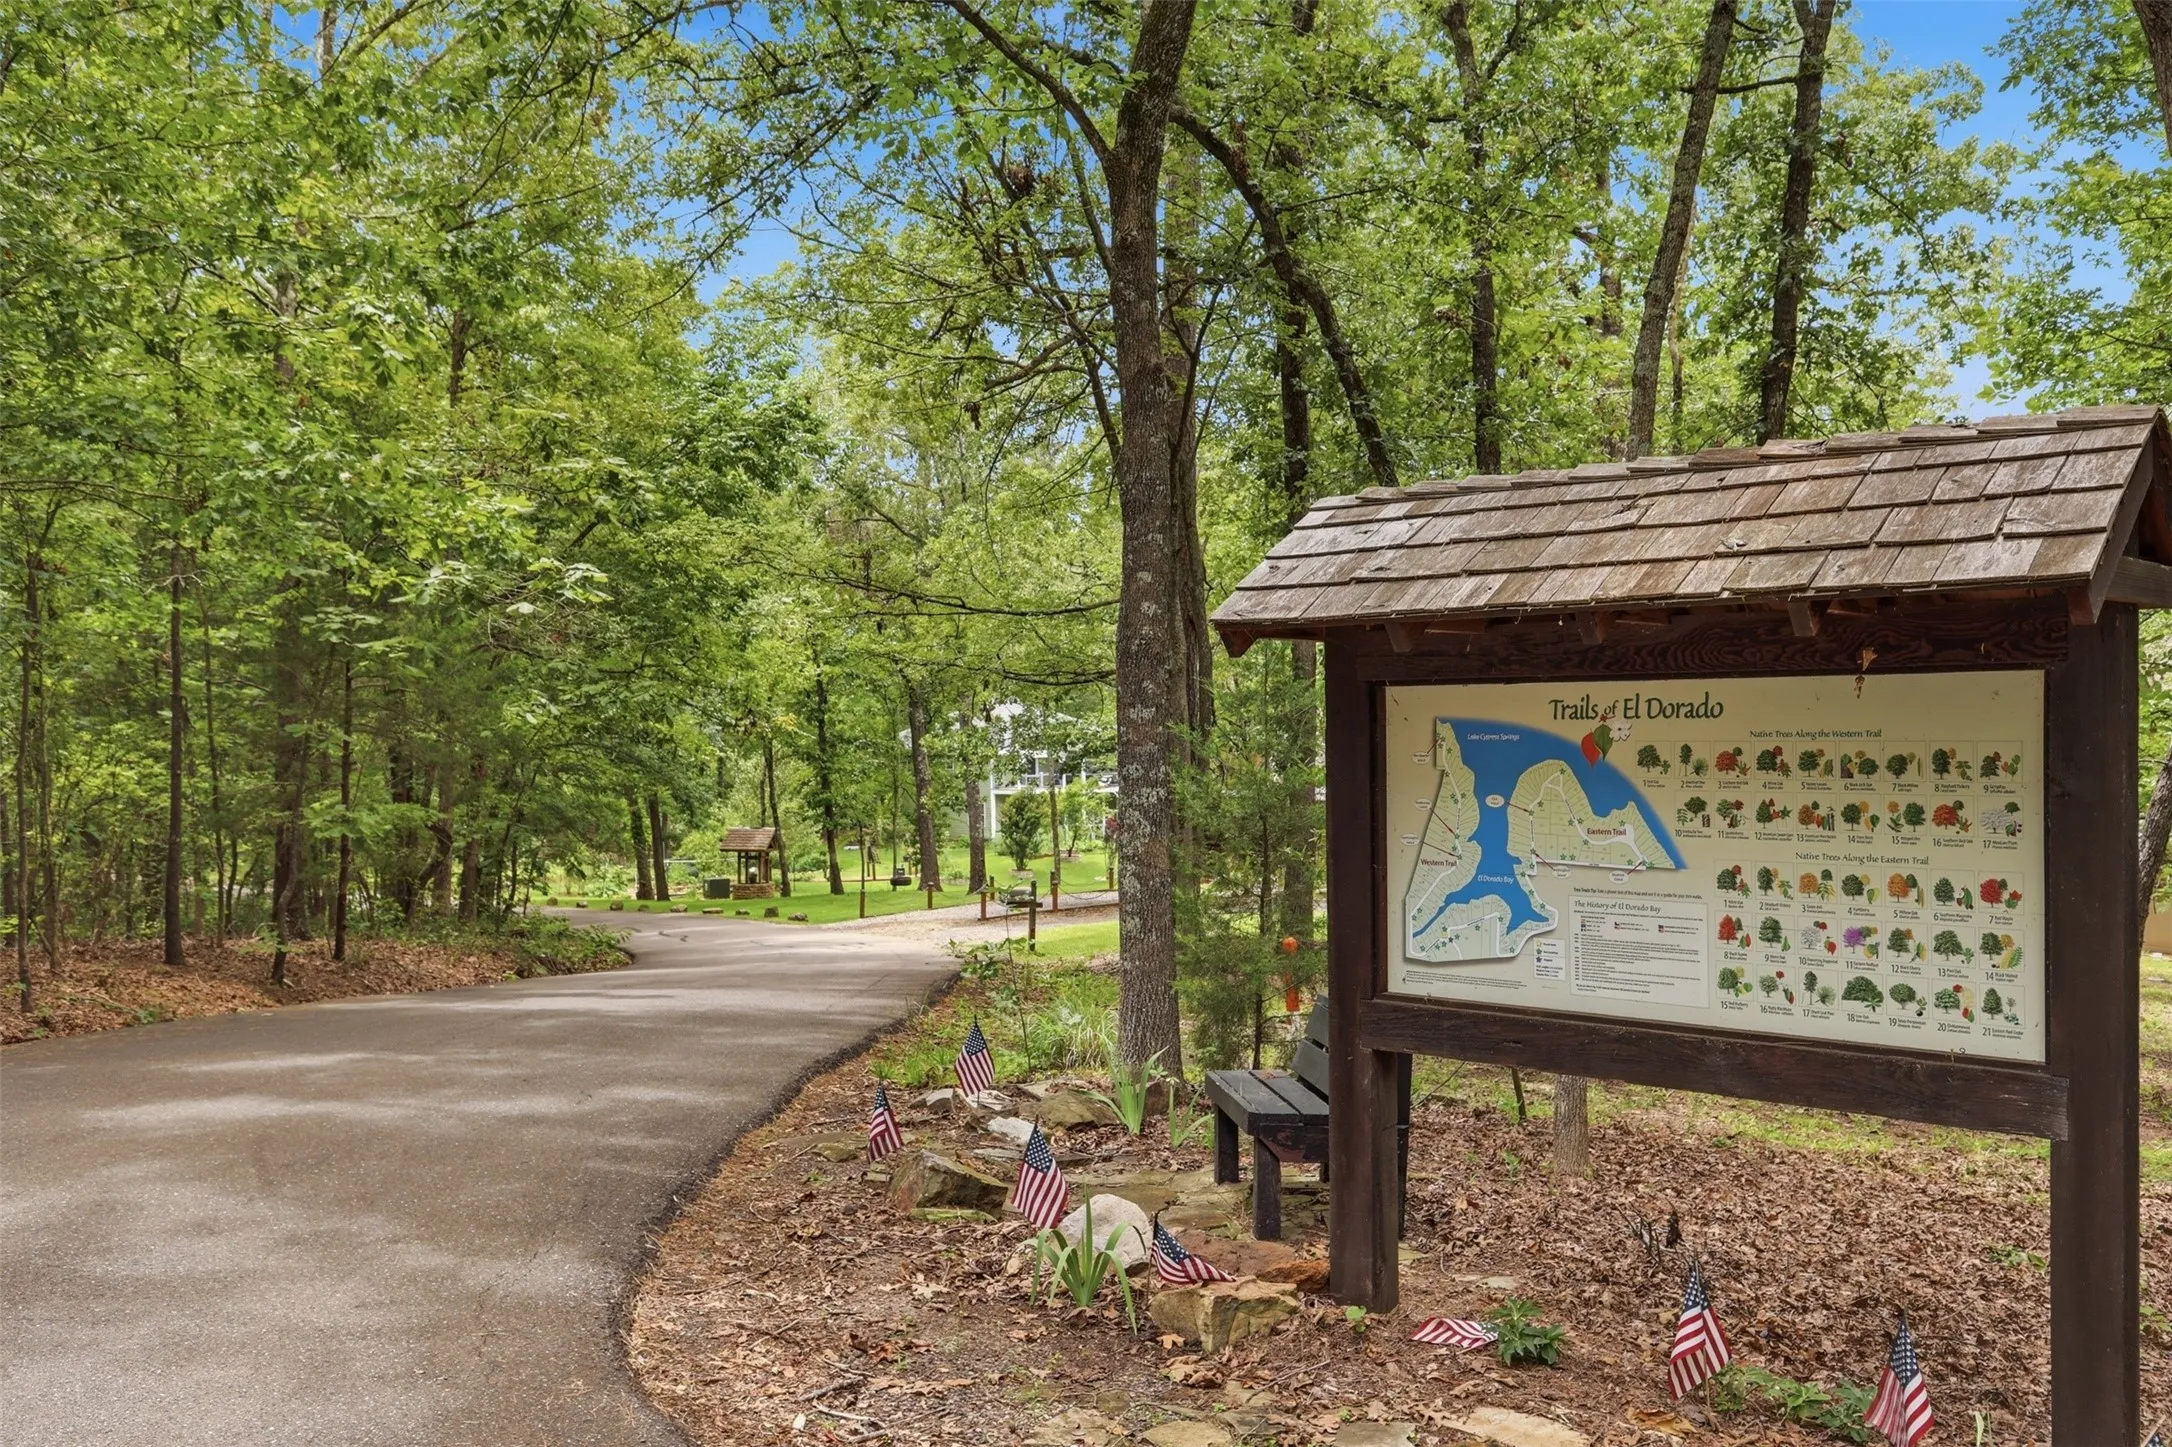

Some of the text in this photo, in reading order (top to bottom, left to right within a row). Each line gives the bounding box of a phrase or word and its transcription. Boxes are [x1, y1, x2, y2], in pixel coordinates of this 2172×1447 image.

[1549, 691, 1724, 721] Trails of El Dorado
[1500, 733, 1520, 742] Springs
[1750, 729, 1882, 740] Native Trees Along the Western Trail
[1642, 779, 1646, 787] 1
[1681, 780, 1685, 788] 2
[1718, 780, 1722, 789] 3
[1762, 781, 1767, 789] 4
[1801, 781, 1806, 790] 5
[1844, 782, 1849, 791] 6
[1892, 782, 1897, 791] 7
[1934, 783, 1939, 792] 8
[1983, 784, 1989, 793] 9
[1586, 827, 1627, 836] Eastern Trail
[1675, 829, 1682, 837] 10
[1717, 830, 1724, 838] 11
[1755, 831, 1762, 840] 12
[1797, 833, 1804, 842] 13
[1848, 834, 1856, 843] 14
[1892, 836, 1899, 845] 15
[1933, 838, 1941, 847] 16
[1983, 839, 1991, 849] 17
[1421, 858, 1457, 867] Western Trail
[1796, 852, 1929, 865] Native Trees Along the Eastern Trail
[1484, 875, 1504, 883] Dorado
[1503, 876, 1515, 885] Bay
[1574, 900, 1662, 915] The History of El Dorado Bay
[1723, 899, 1727, 907] 1
[1759, 901, 1764, 910] 2
[1802, 904, 1806, 912] 3
[1848, 907, 1852, 916] 4
[1894, 909, 1898, 919] 5
[1934, 911, 1939, 921] 6
[1989, 915, 1994, 924] 7
[1724, 950, 1729, 959] 8
[1765, 953, 1770, 962] 9
[1799, 957, 1807, 965] 10
[1846, 961, 1853, 969] 11
[1891, 964, 1900, 973] 12
[1938, 967, 1946, 977] 13
[1985, 971, 1994, 981] 14
[1720, 1000, 1728, 1009] 15
[1760, 1005, 1768, 1013] 16
[1803, 1008, 1810, 1017] 17
[1847, 1013, 1855, 1022] 18
[1889, 1017, 1897, 1026] 19
[1937, 1022, 1946, 1032] 20
[1982, 1027, 1991, 1036] 21
